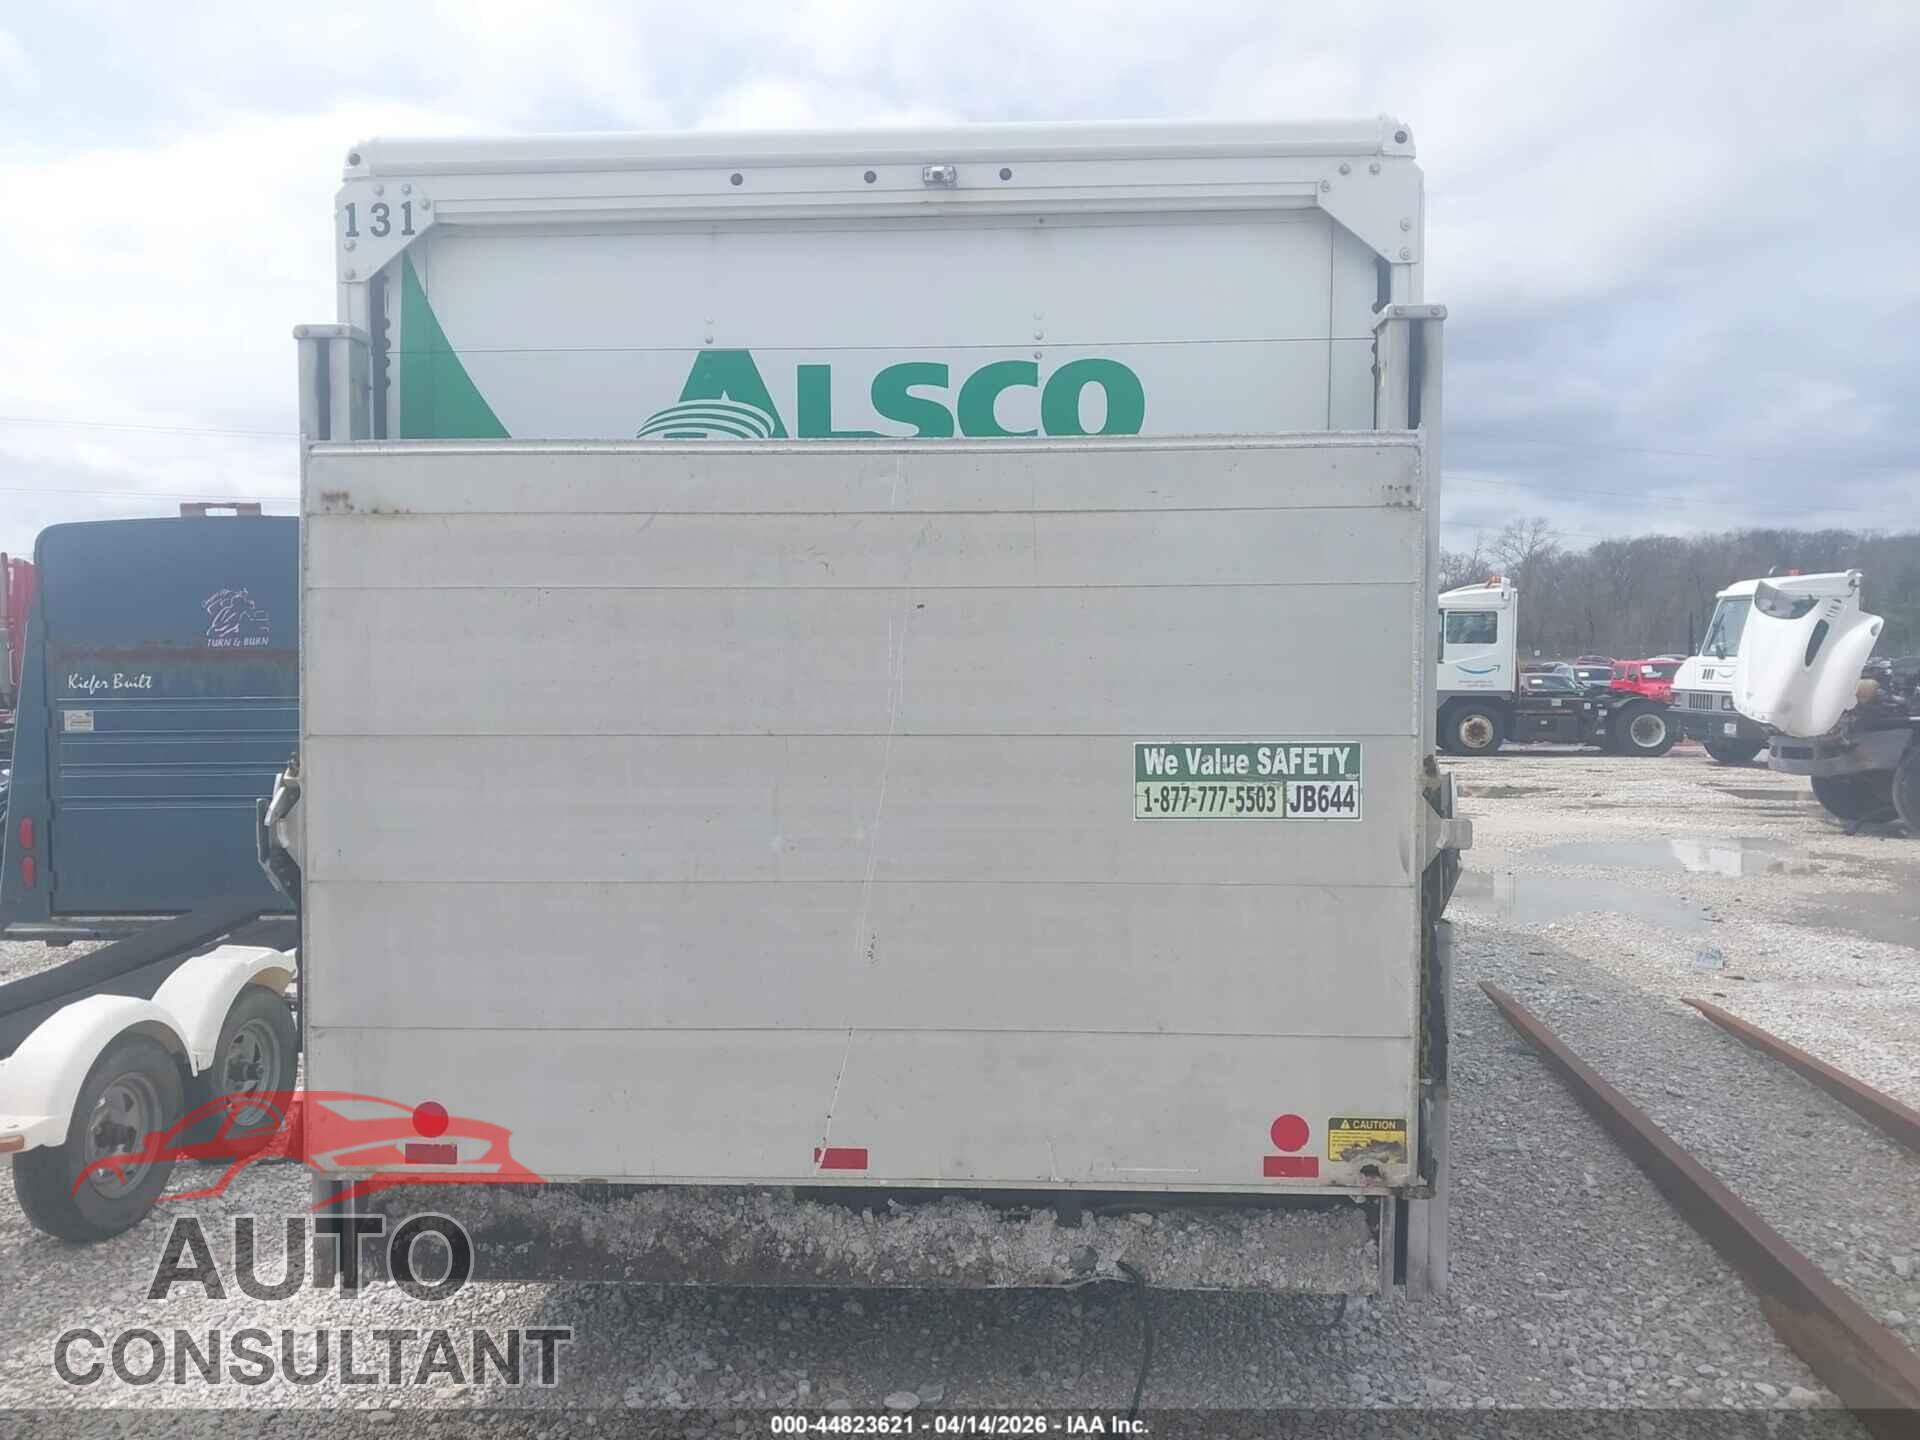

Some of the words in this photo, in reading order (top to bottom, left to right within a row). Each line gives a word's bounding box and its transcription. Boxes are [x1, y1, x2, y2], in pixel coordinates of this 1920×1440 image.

[344, 200, 416, 237] 131
[636, 349, 1146, 439] ALSCO
[68, 673, 109, 696] Kiefer
[113, 673, 153, 689] Built
[1143, 748, 1179, 775] We
[1185, 748, 1250, 775] Value
[1257, 747, 1351, 775] SAFETY
[1144, 786, 1277, 813] 1-877-777-5503
[1290, 784, 1356, 813] JB644
[1352, 1119, 1397, 1130] CAUTION
